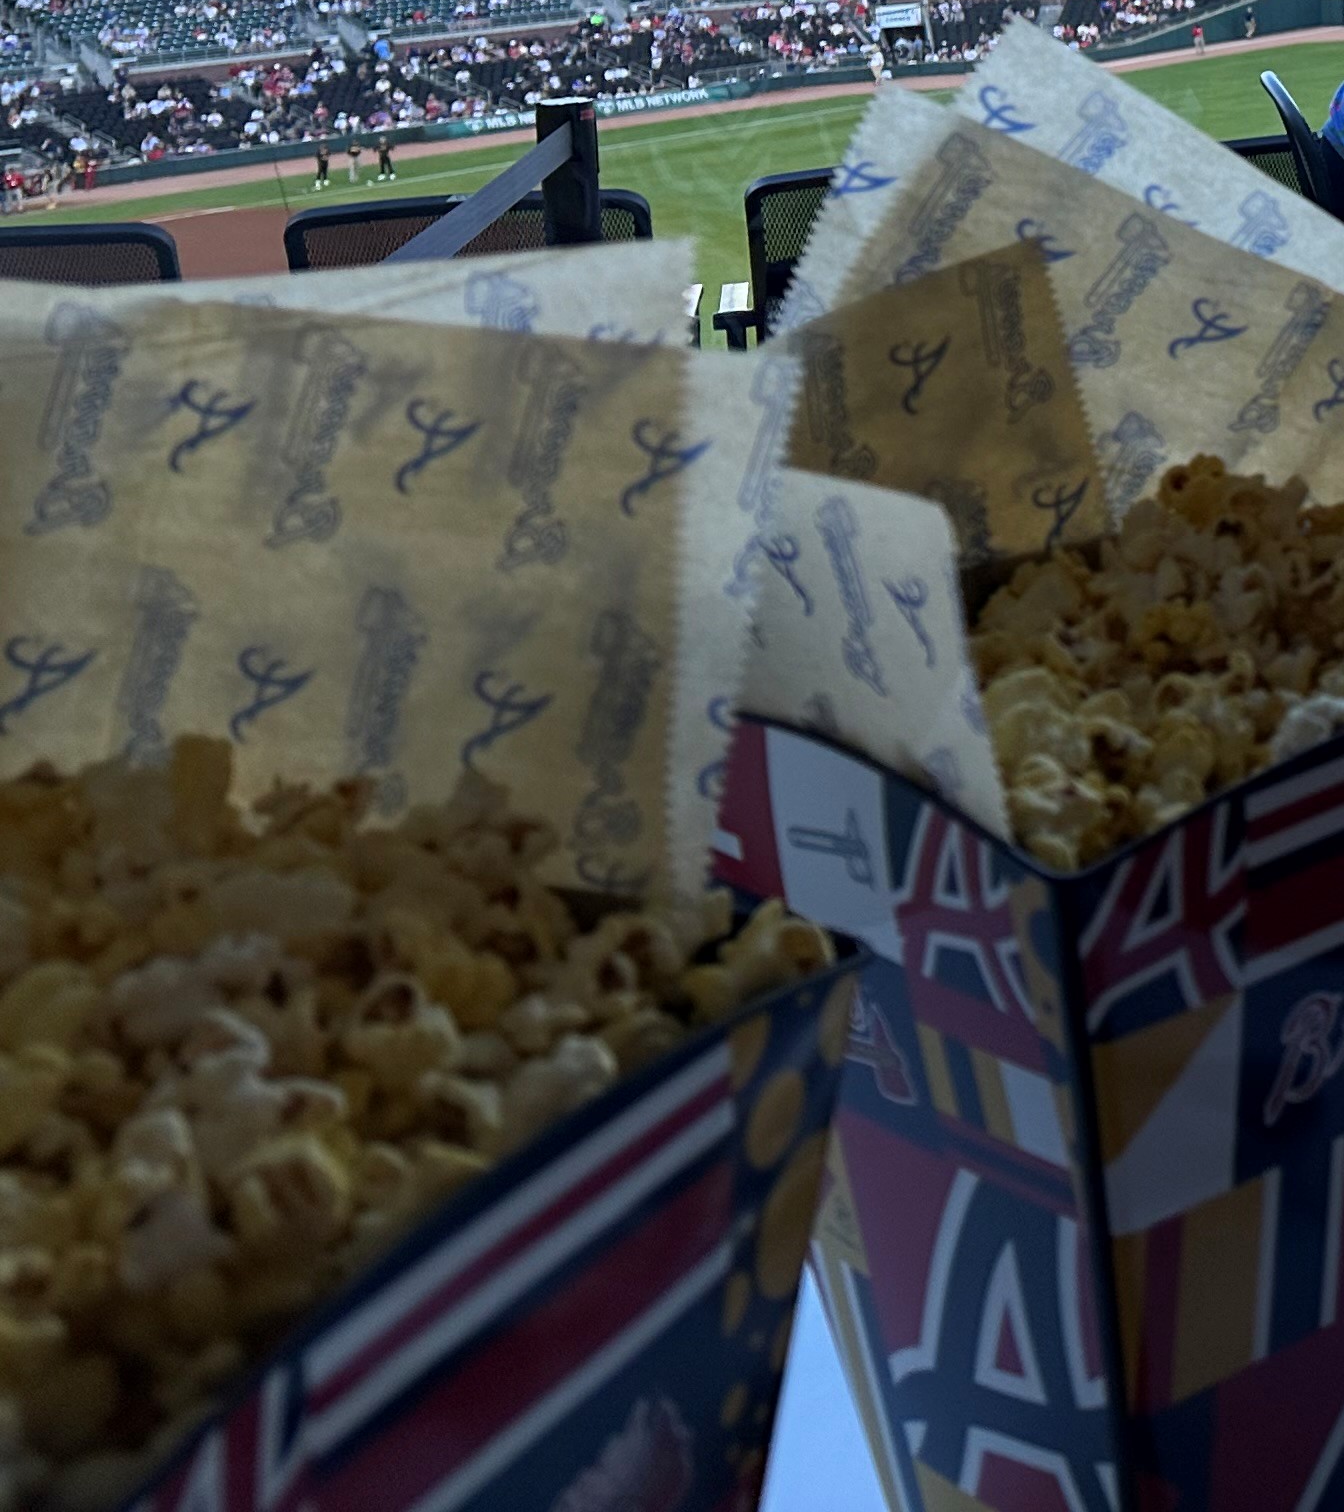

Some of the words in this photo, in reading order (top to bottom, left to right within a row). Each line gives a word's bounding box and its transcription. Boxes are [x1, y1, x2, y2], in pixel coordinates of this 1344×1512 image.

[616, 98, 644, 113] MLB
[647, 88, 709, 108] NETWORK
[486, 113, 515, 129] MLB
